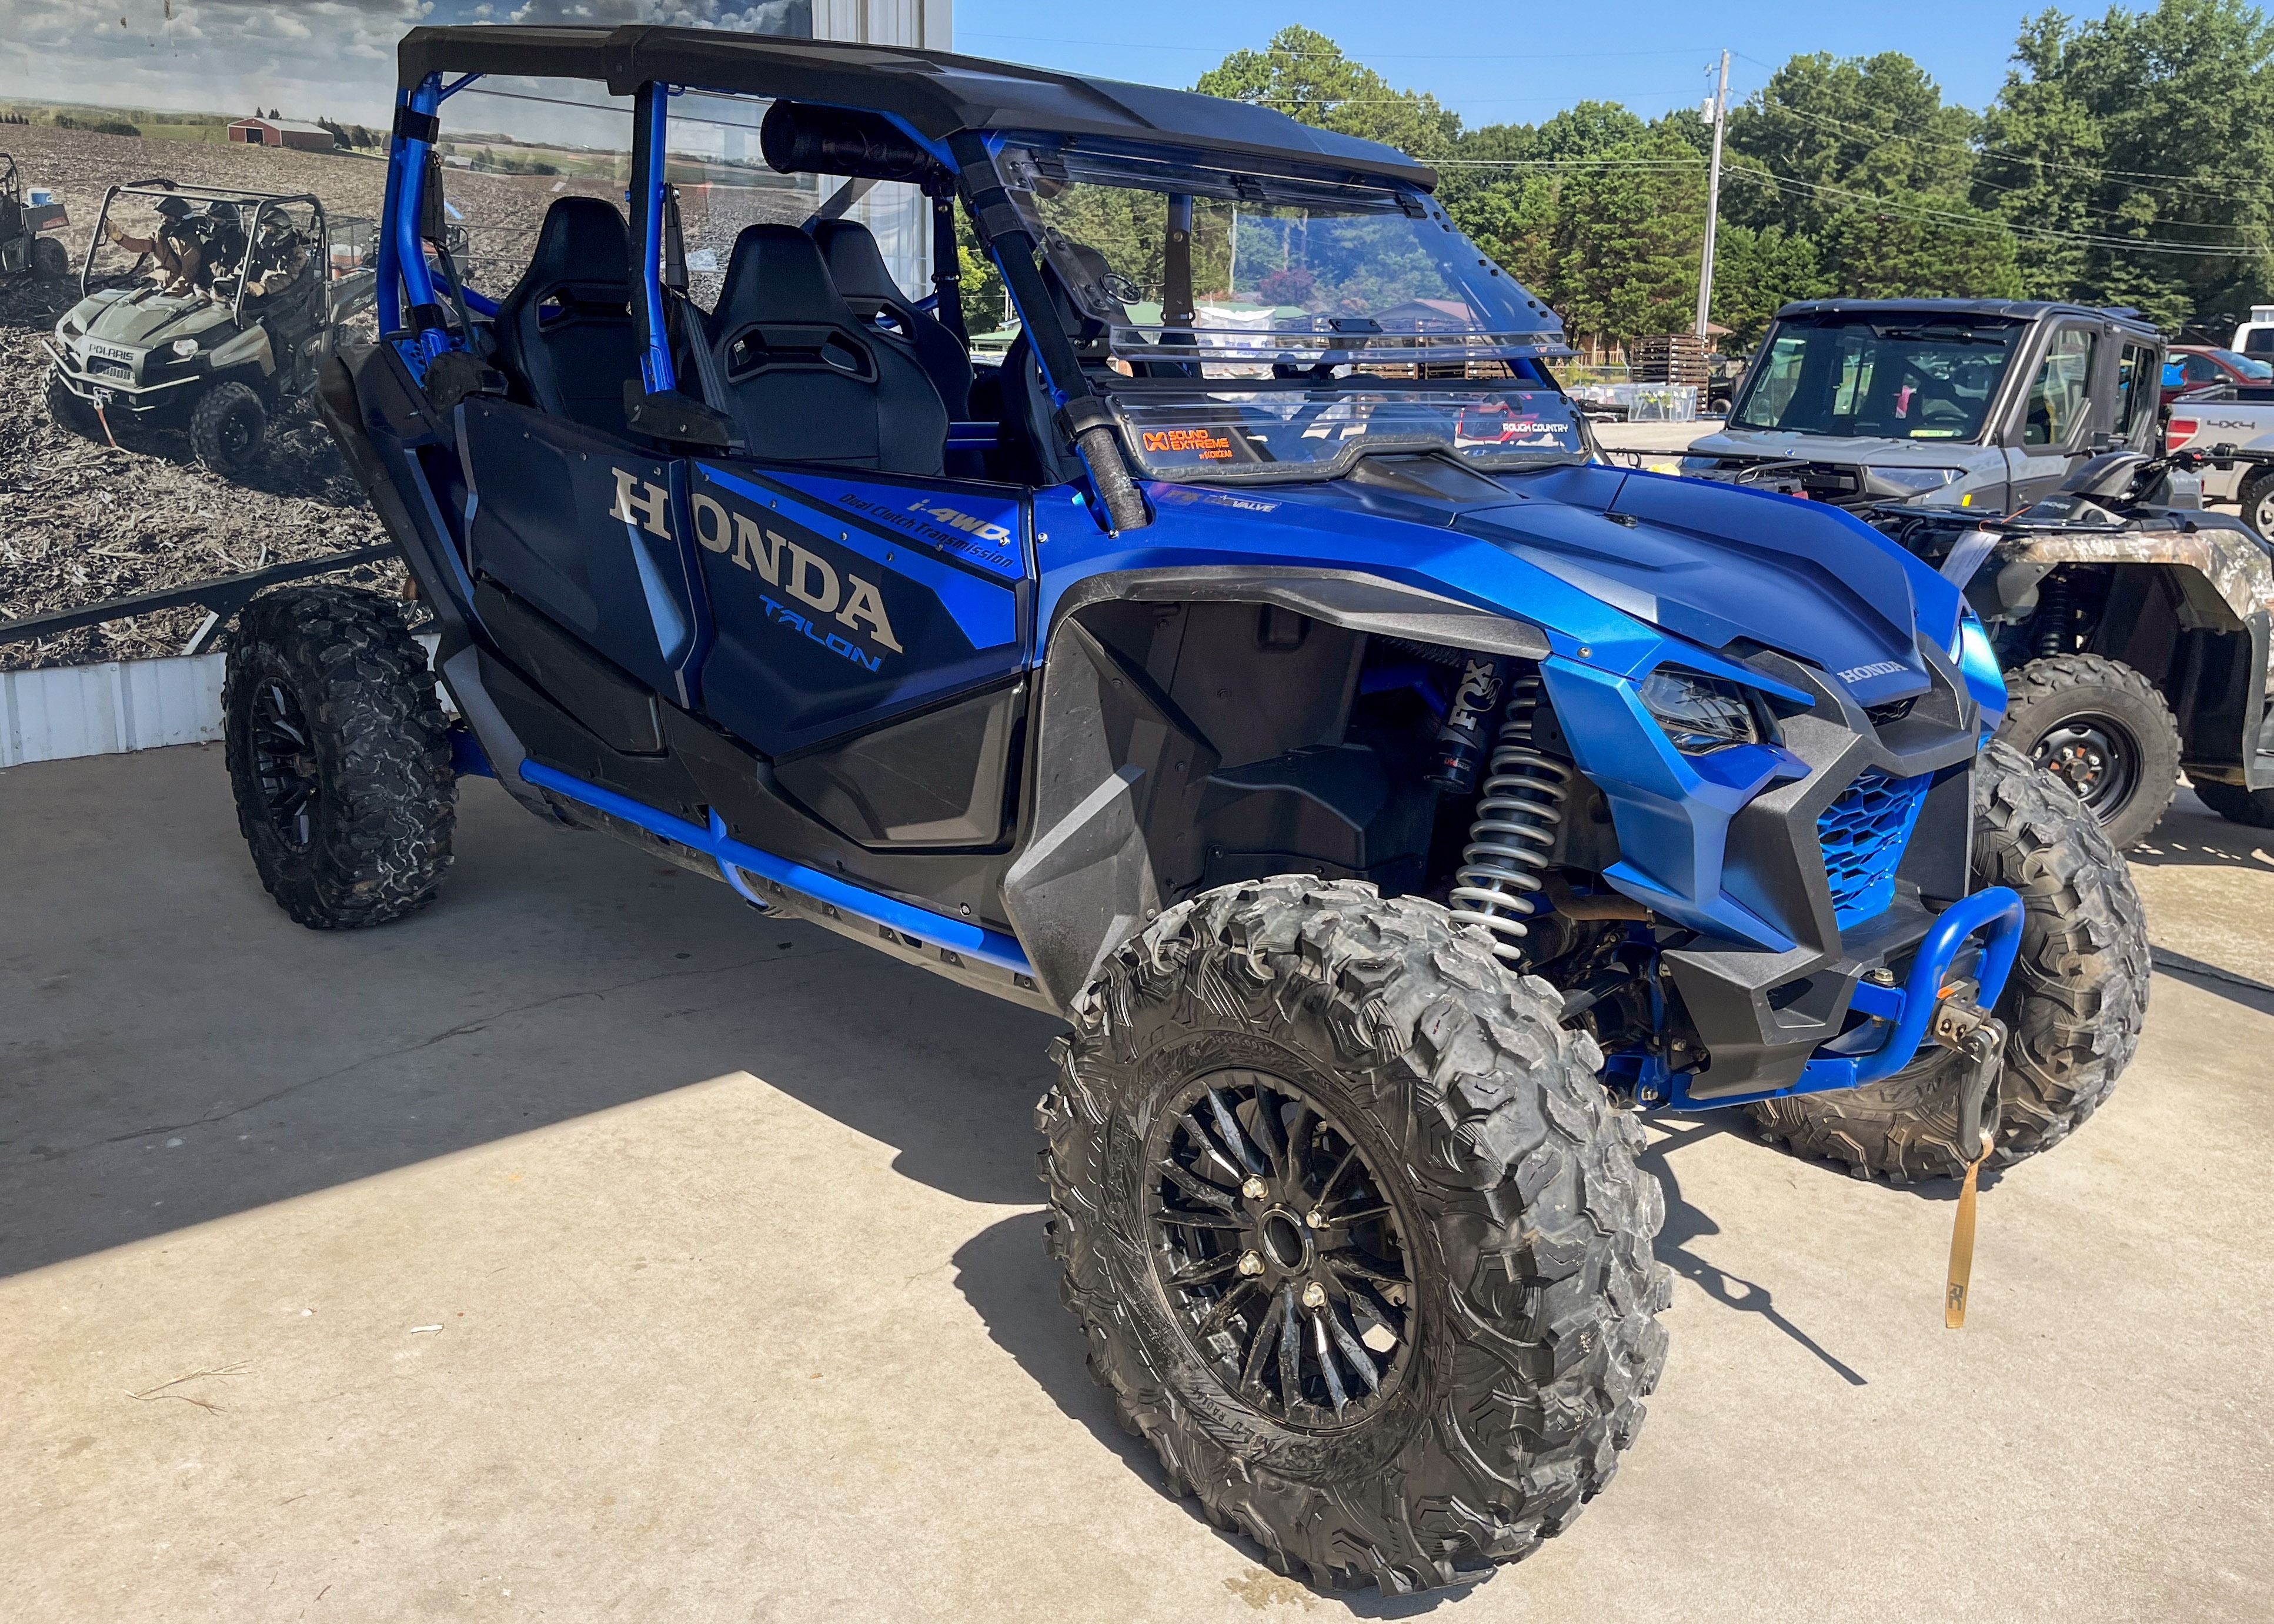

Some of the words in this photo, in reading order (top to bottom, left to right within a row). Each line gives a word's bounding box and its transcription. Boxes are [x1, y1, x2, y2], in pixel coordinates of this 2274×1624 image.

[89, 343, 134, 360] POLARIS
[1168, 429, 1209, 441] SOUND
[1502, 423, 1531, 432] ROUGH
[1532, 423, 1569, 433] COUNTRY
[1170, 437, 1230, 451] EXTREME
[1233, 500, 1275, 513] VALVE
[839, 493, 870, 512] Dual
[870, 505, 916, 529] Clutch
[913, 521, 1016, 568] Transmission
[907, 499, 1010, 540] i-4WD
[609, 466, 903, 653] HONDA
[759, 594, 881, 673] TALON
[1836, 661, 1909, 683] HONDA
[1448, 659, 1503, 731] FOX
